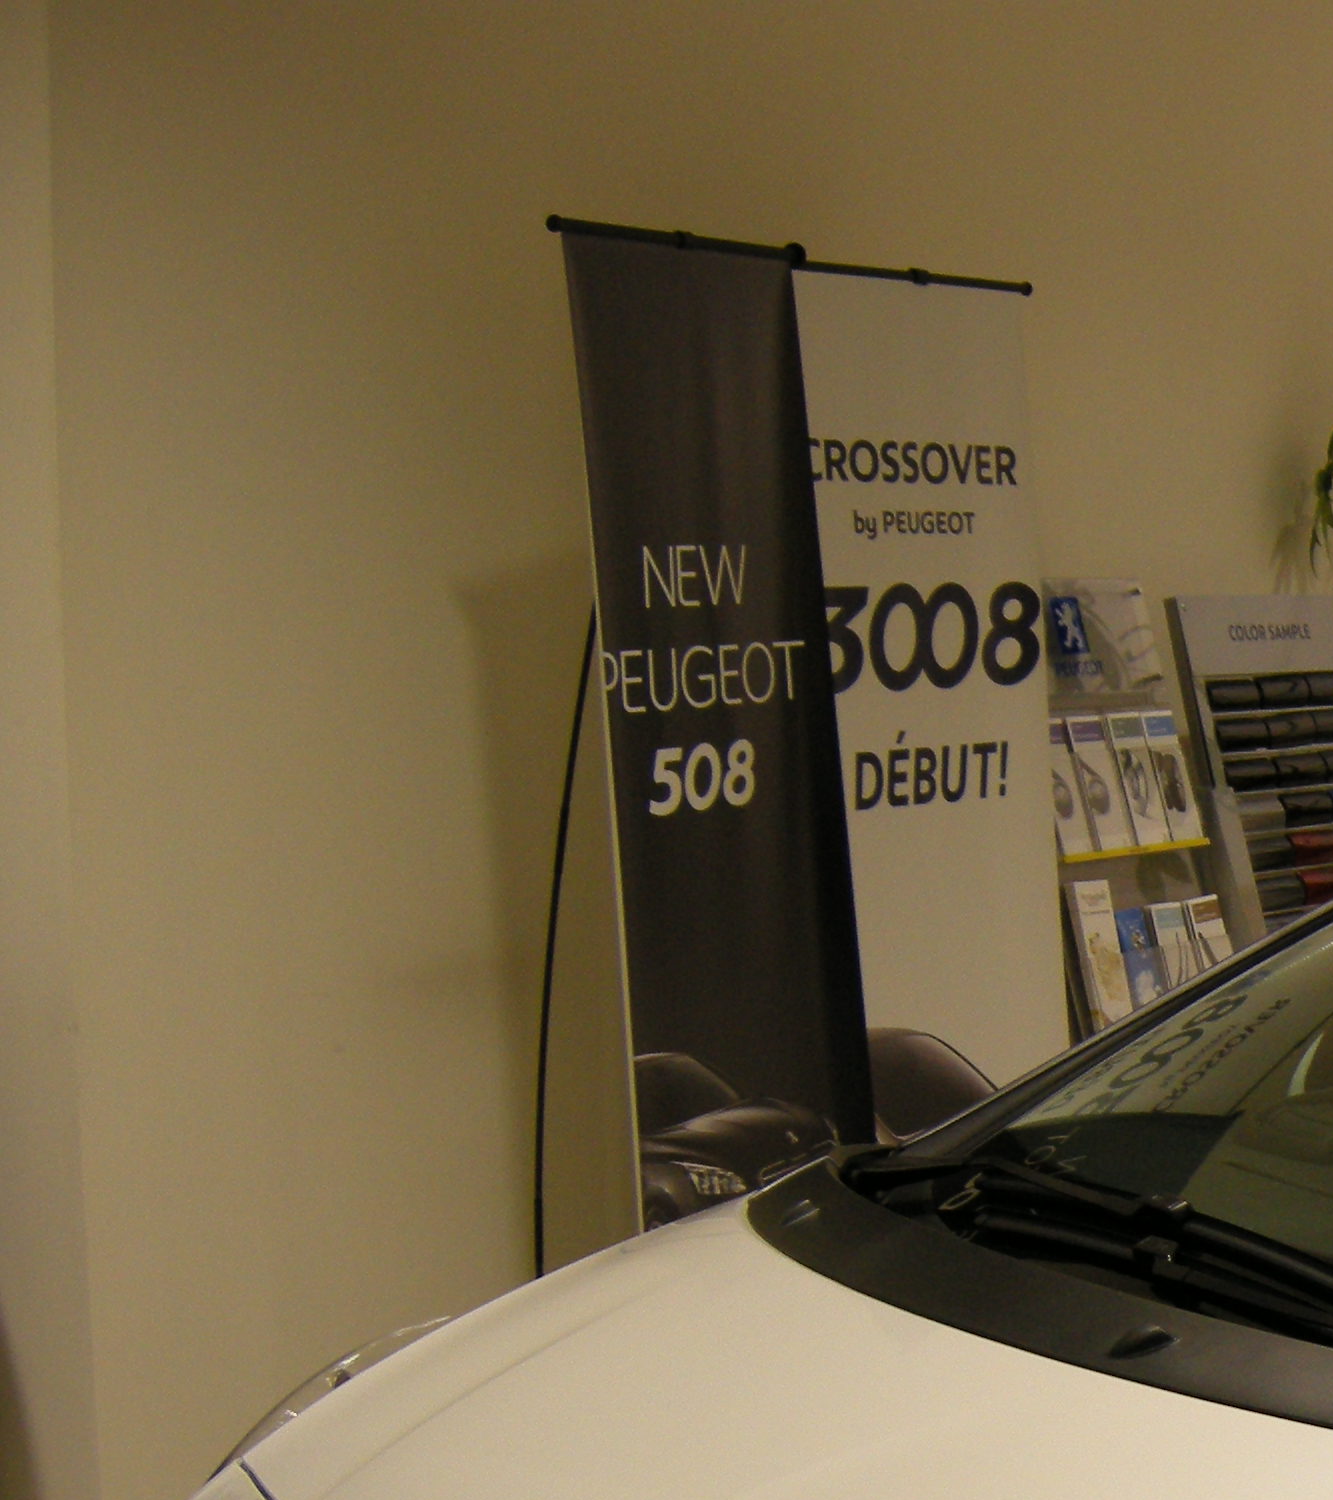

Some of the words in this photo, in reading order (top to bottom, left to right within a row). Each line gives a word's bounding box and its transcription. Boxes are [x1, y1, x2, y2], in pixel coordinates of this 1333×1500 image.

[853, 509, 878, 540] by
[882, 510, 976, 535] PEUGEOT
[641, 544, 748, 608] NEW
[822, 580, 1041, 695] 3008
[1227, 623, 1267, 641] COLOR
[1267, 623, 1312, 641] SAMPLE
[602, 639, 806, 714] PEUGEOT
[648, 738, 756, 817] 508
[853, 730, 1010, 811] DÉBUT!
